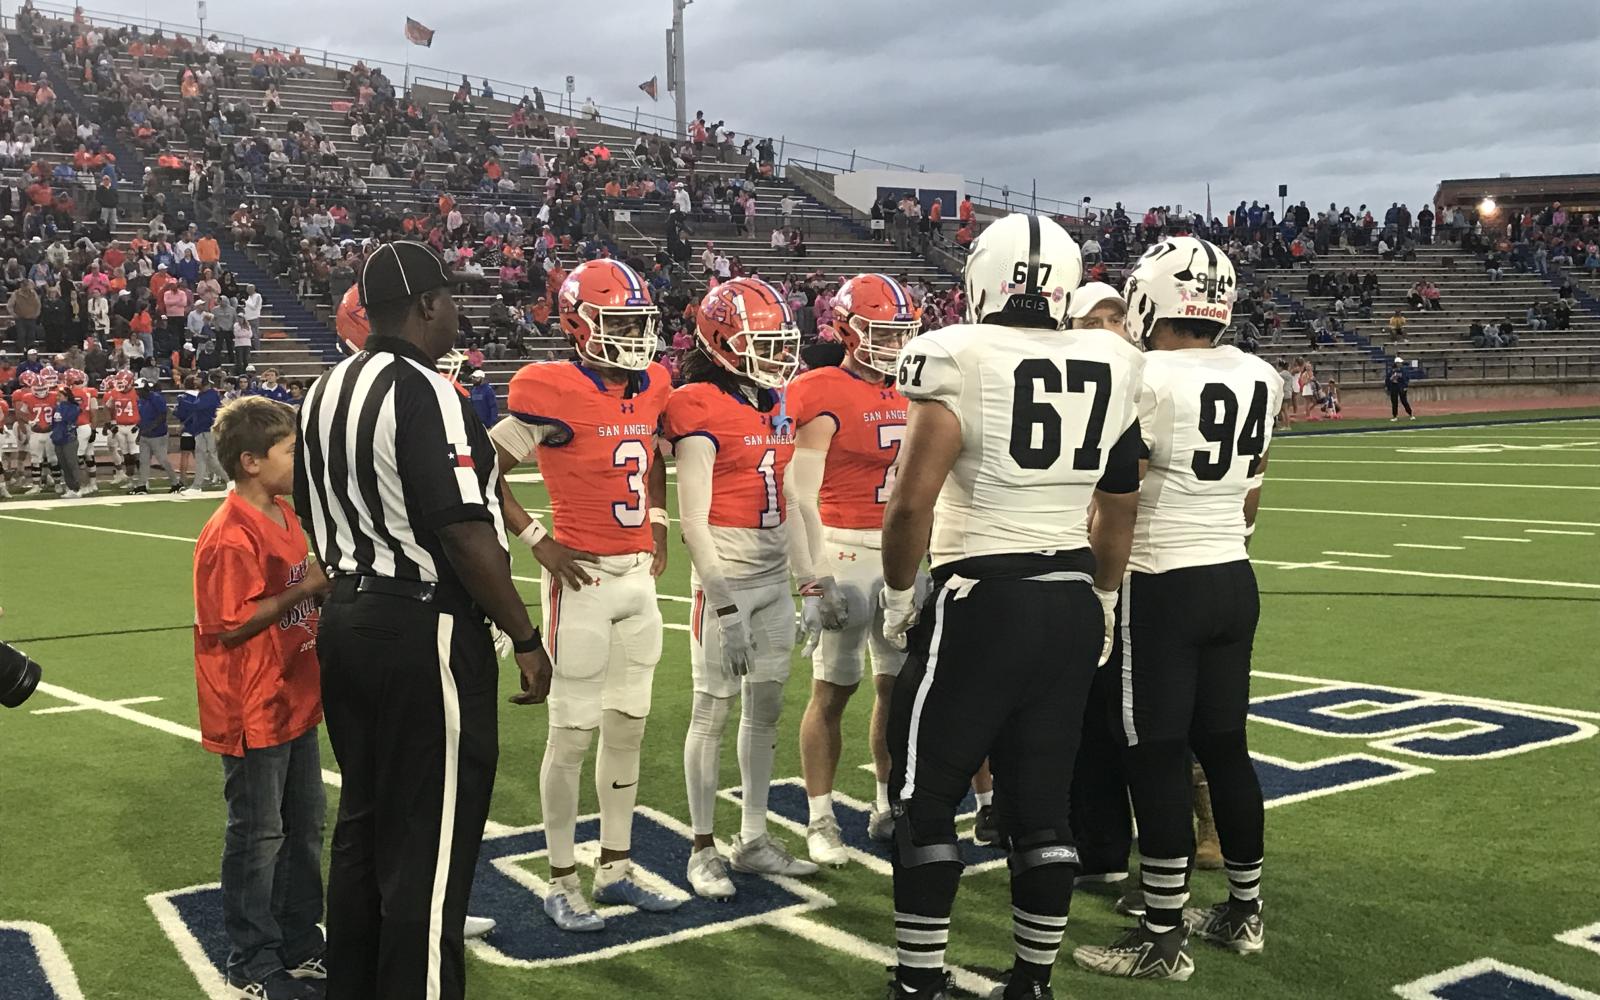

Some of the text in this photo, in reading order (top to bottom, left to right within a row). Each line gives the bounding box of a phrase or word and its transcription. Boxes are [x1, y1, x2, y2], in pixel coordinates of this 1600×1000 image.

[1013, 261, 1052, 287] 67
[1195, 272, 1226, 295] 94
[1011, 298, 1046, 311] VICIS
[1184, 304, 1228, 320] Riddell
[898, 354, 927, 387] 67
[32, 406, 53, 423] 72
[863, 409, 907, 422] SAN ANGE
[1009, 358, 1112, 470] 67
[598, 424, 652, 437] SAN ANGEL
[743, 435, 762, 446] SAN
[1191, 380, 1268, 481] 94
[875, 424, 907, 504] 7
[612, 440, 648, 528] 3
[757, 448, 781, 529] 1
